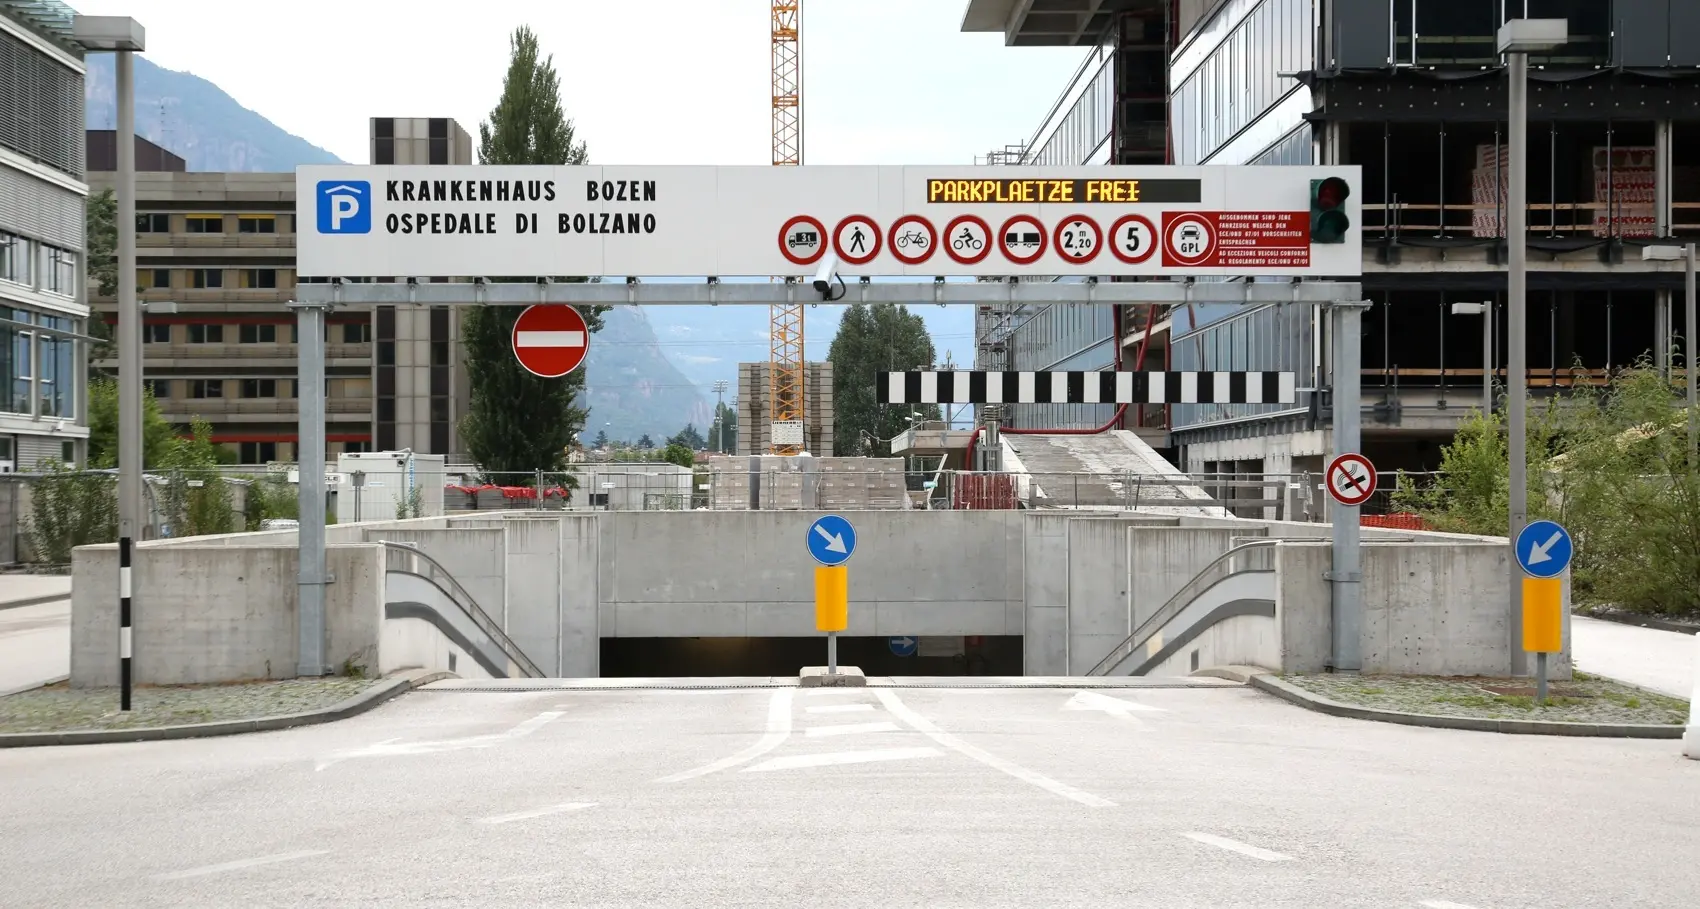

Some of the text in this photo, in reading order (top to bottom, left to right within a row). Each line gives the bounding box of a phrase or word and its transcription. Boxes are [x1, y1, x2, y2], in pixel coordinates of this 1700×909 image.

[386, 180, 656, 201] KRANKENHAUS BOZEN
[930, 180, 1140, 202] PARKPLAETZE FREI
[331, 195, 359, 230] P
[386, 213, 656, 234] OSPEDALE DI BOLZANO
[1126, 227, 1140, 251] 5
[1181, 243, 1200, 253] GPL
